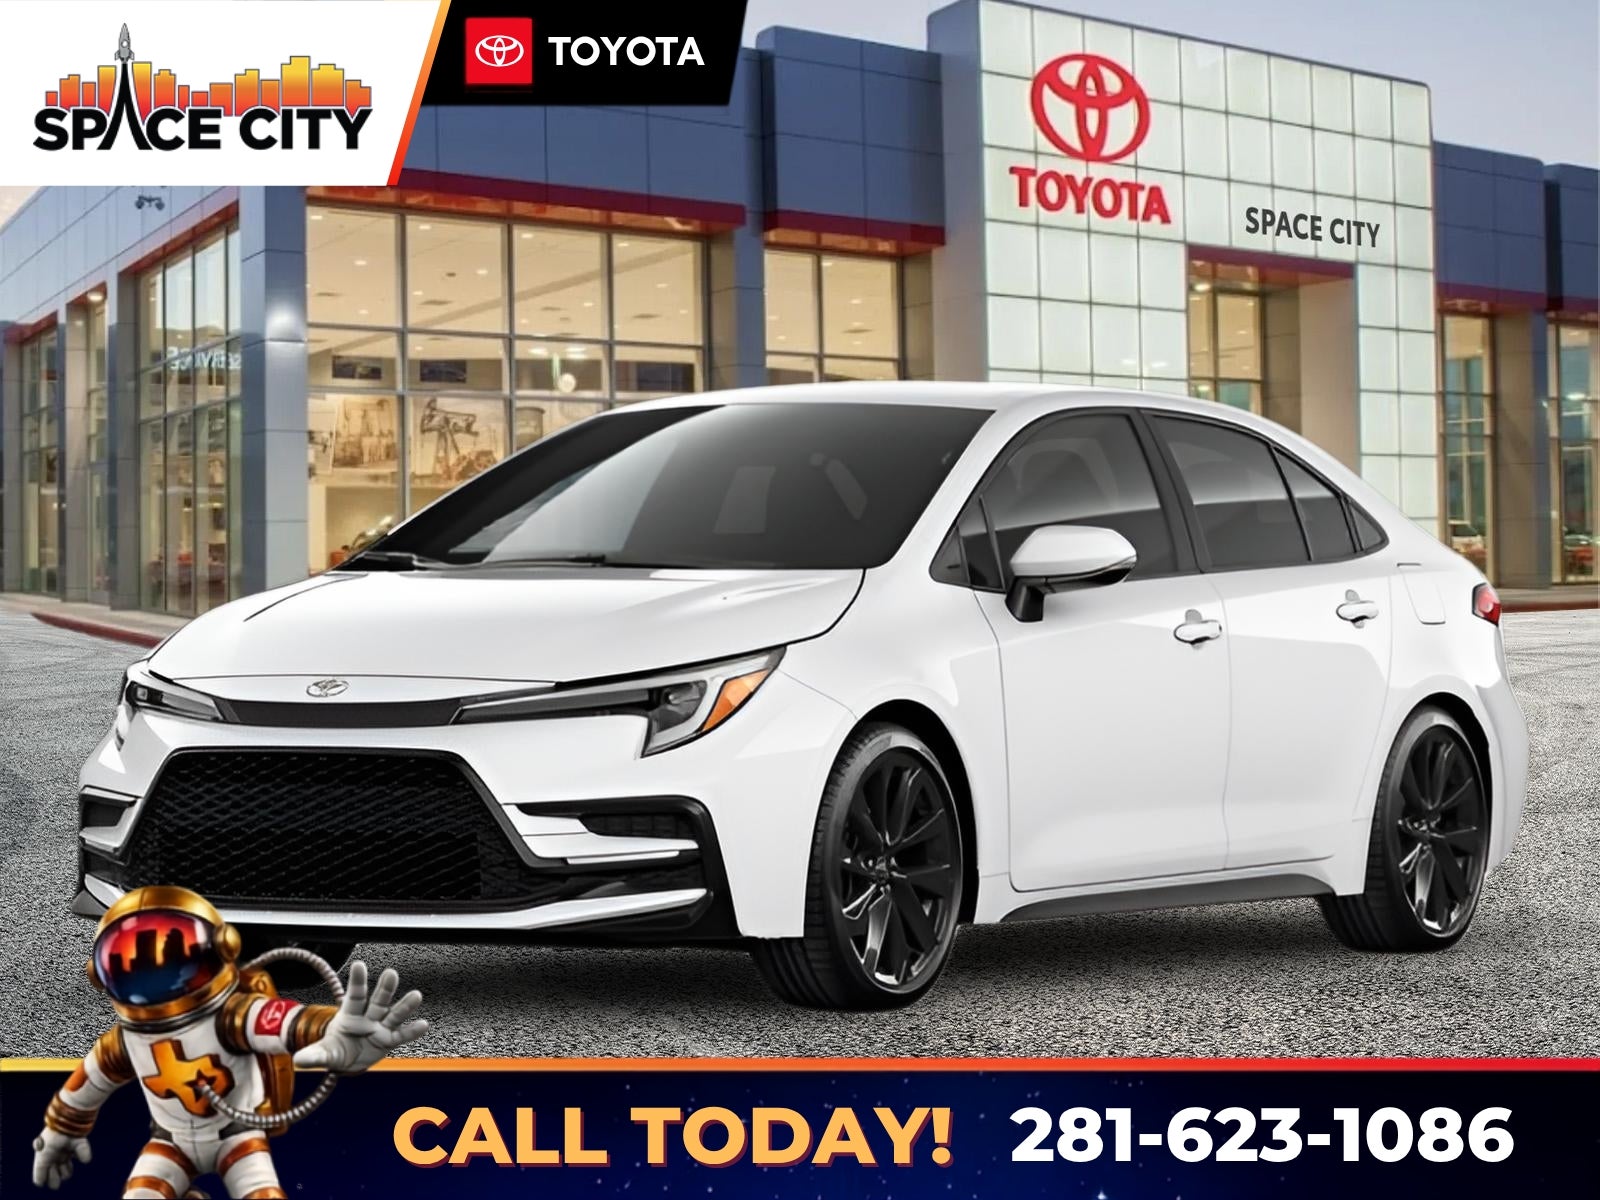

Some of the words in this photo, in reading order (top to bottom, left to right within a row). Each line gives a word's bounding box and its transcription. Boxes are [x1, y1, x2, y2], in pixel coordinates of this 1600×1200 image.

[1009, 166, 1171, 224] TOYOTA
[1245, 207, 1323, 242] SPACE
[1330, 217, 1381, 248] CITY
